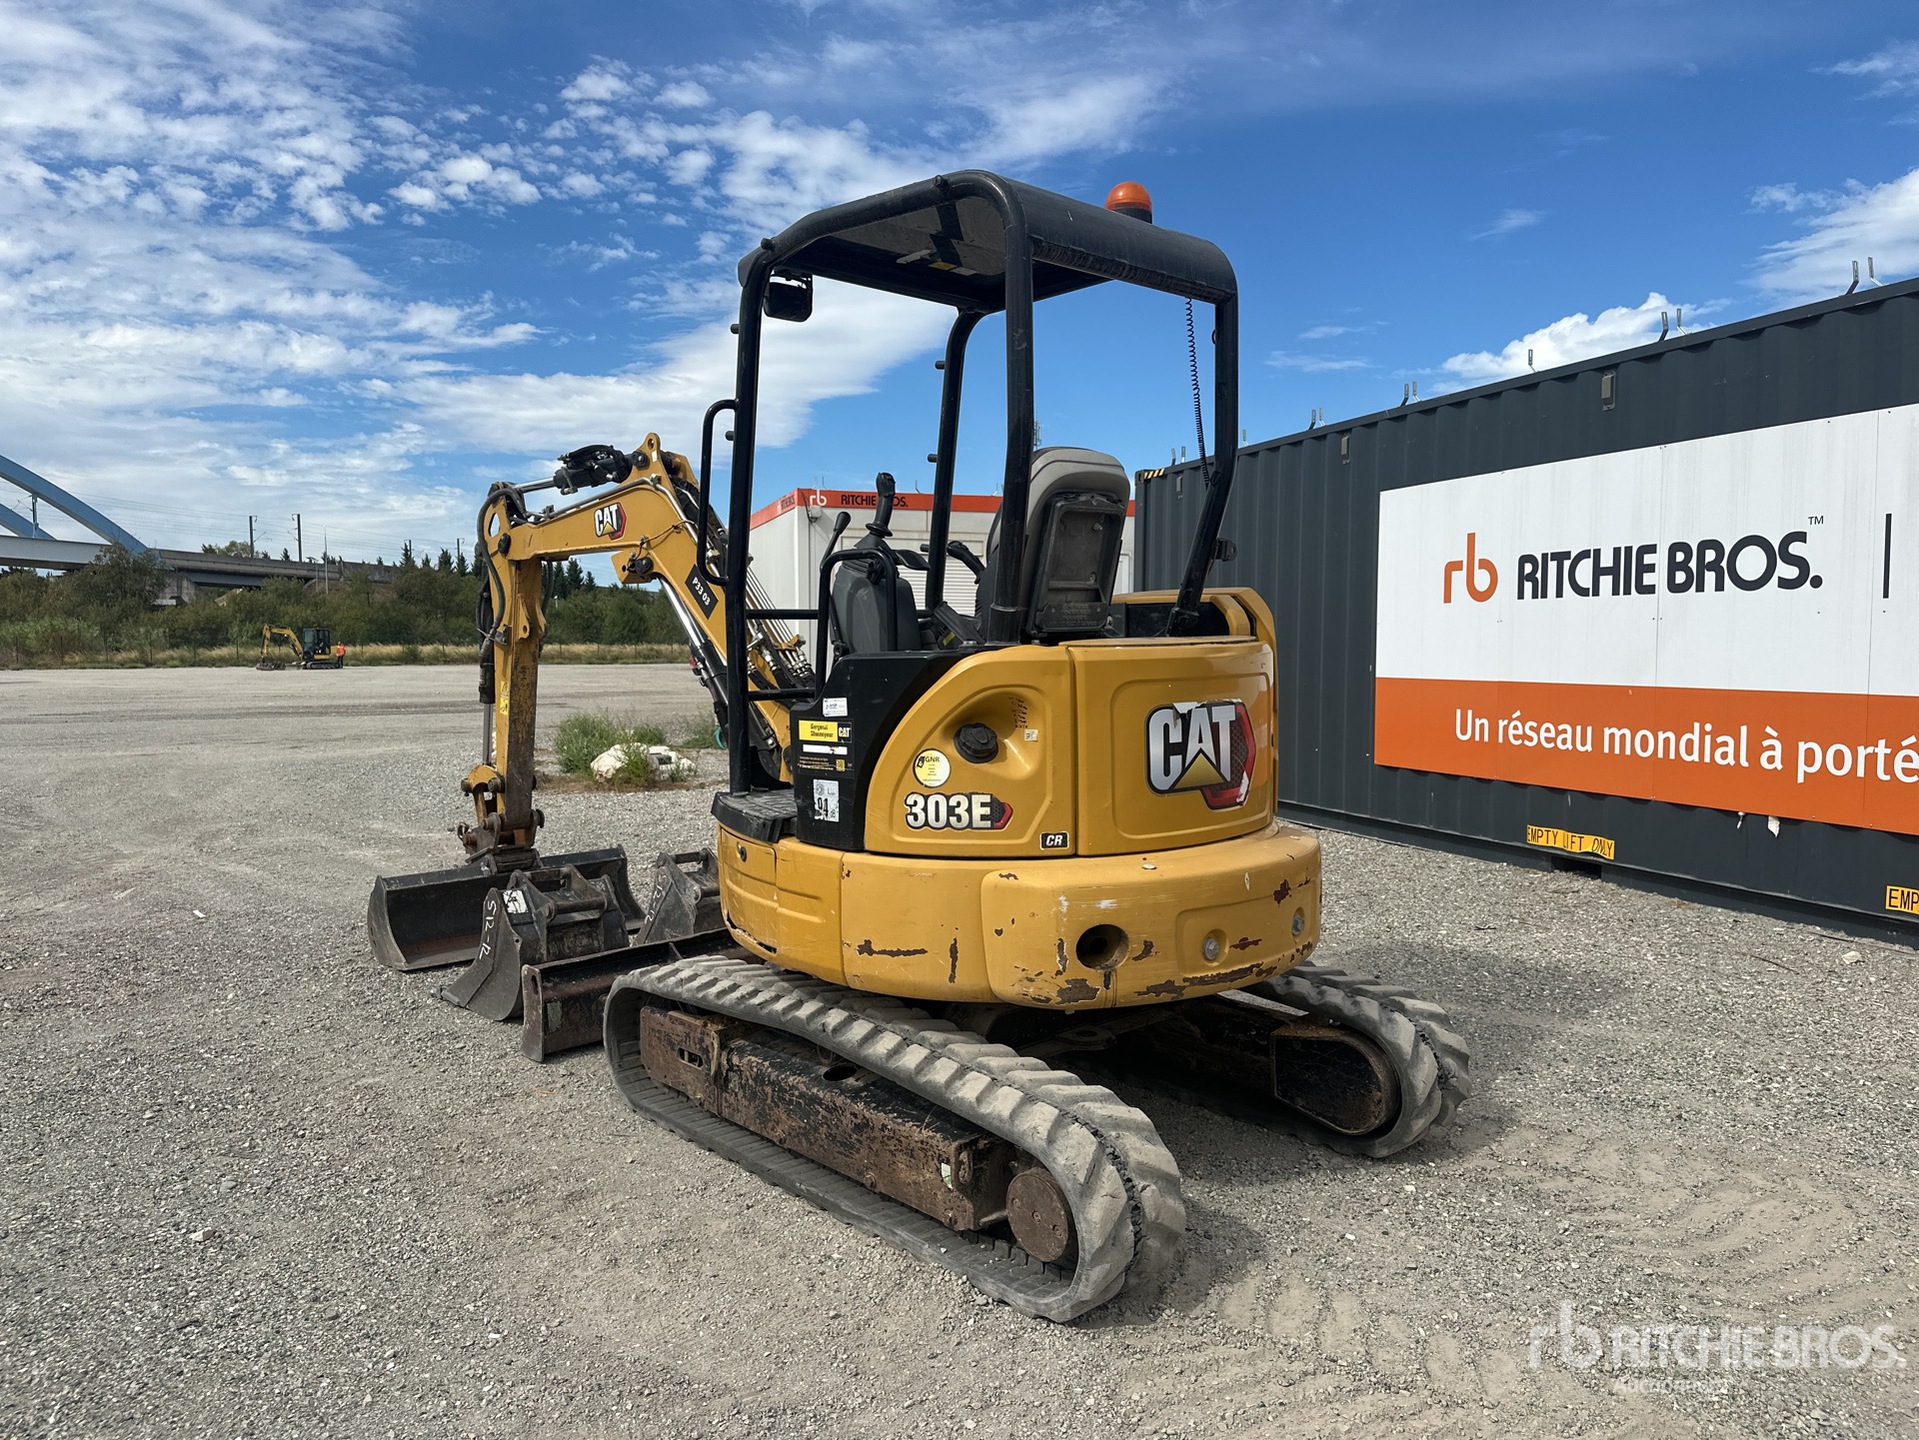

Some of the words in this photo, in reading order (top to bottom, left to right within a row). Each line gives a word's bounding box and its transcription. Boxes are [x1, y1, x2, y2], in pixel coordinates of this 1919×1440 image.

[810, 490, 827, 506] rb
[841, 494, 876, 506] RITCHIE
[594, 503, 618, 537] CAT
[1808, 515, 1824, 525] TM
[1443, 532, 1498, 603] rb
[1517, 543, 1657, 600] RITCHIE
[1666, 530, 1823, 593] BROS.
[692, 576, 704, 595] P33
[702, 592, 711, 606] 03
[838, 727, 851, 737] CAT
[1455, 708, 1489, 743] Un
[1498, 709, 1593, 752] réseau
[1603, 721, 1749, 767] mondial
[1759, 725, 1783, 771] à
[1149, 705, 1236, 791] CAT
[905, 793, 991, 829] 303E
[1046, 835, 1063, 847] CR
[1527, 827, 1559, 845] EMPTY
[1562, 832, 1584, 851] LIFT
[1592, 838, 1613, 857] ONLY
[1888, 888, 1919, 911] EMP
